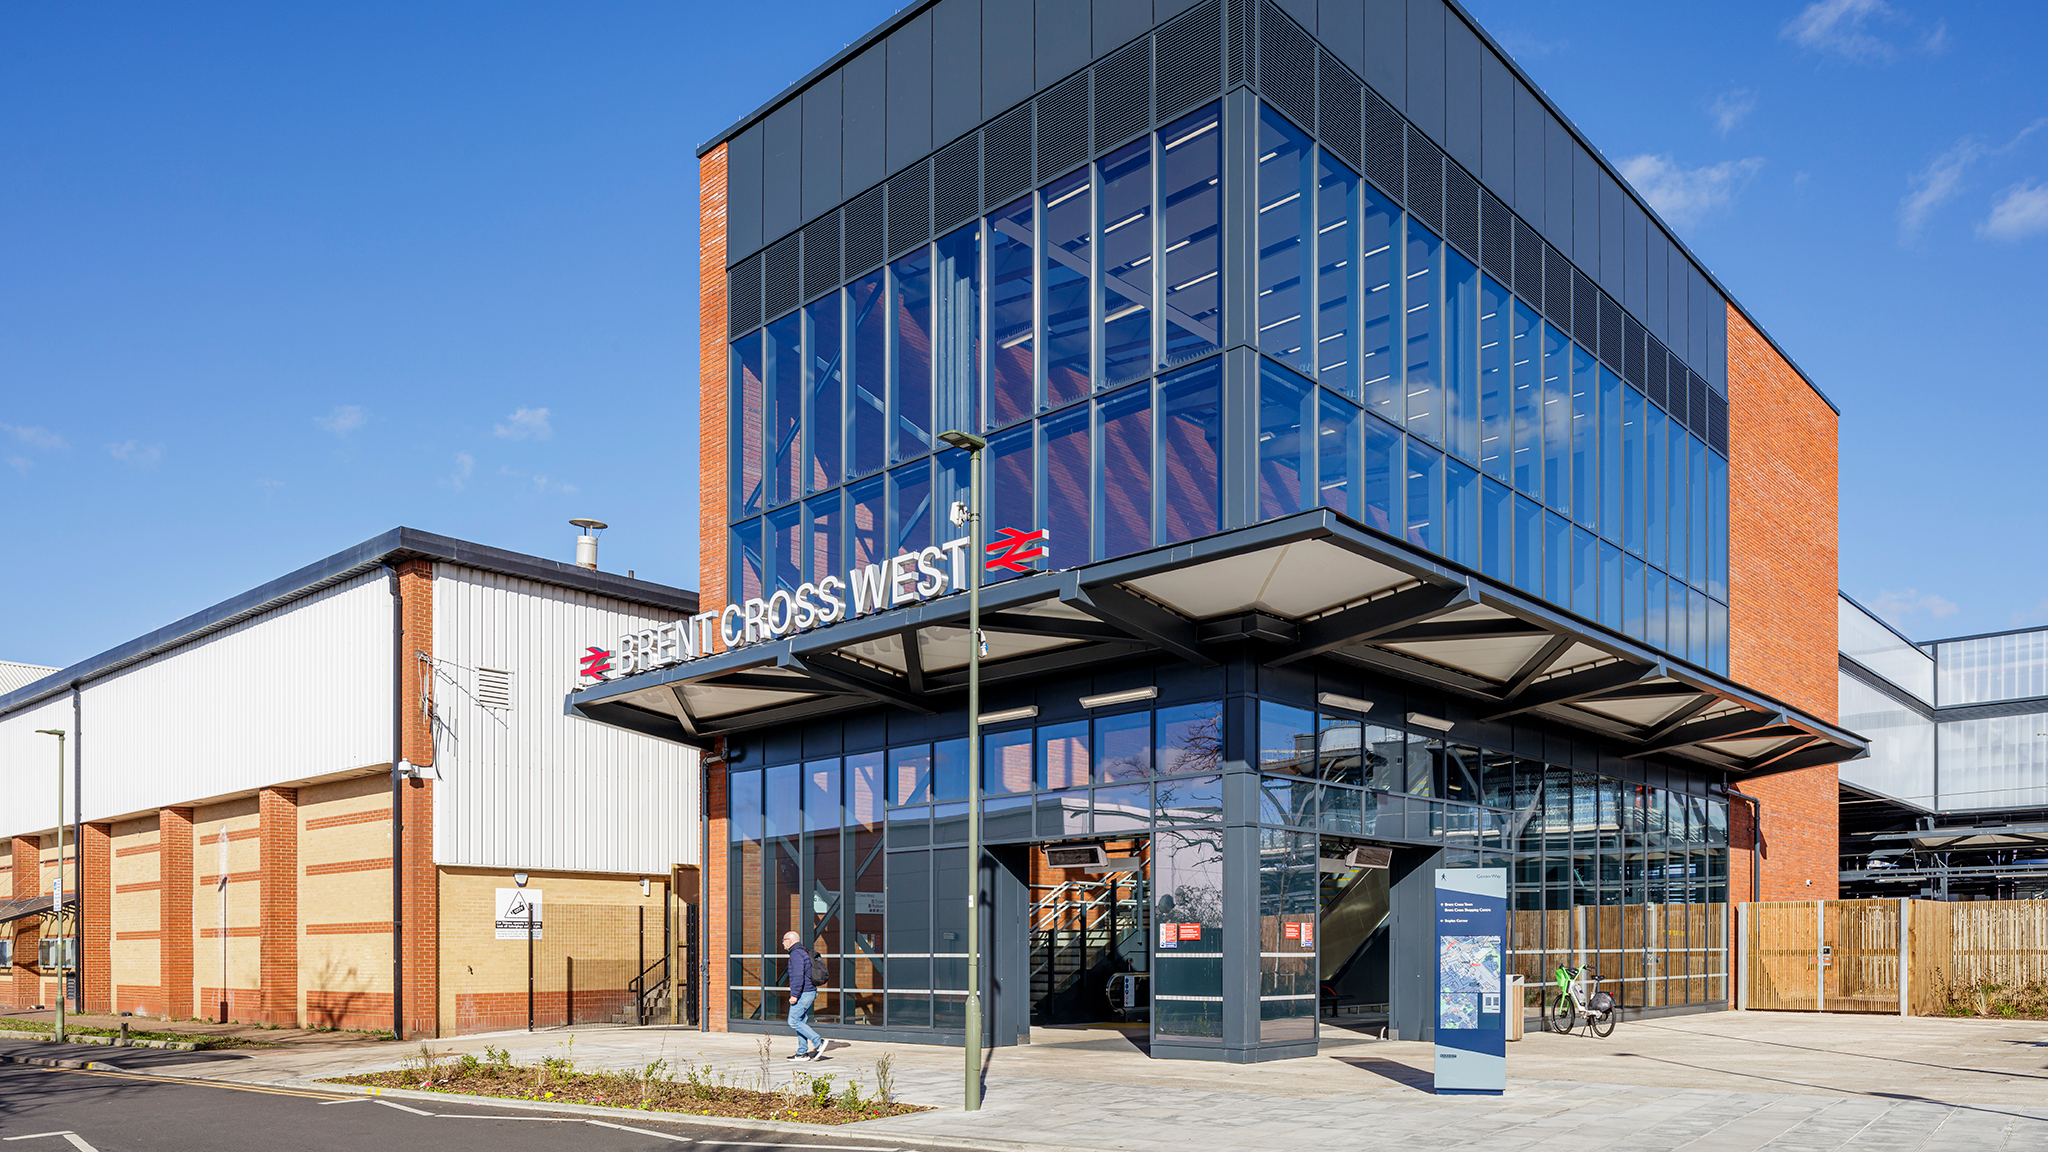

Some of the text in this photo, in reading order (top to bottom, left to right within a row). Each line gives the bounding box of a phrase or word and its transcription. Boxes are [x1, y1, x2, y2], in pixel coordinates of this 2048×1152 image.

[619, 536, 970, 676] BRENT CROSS WEST
